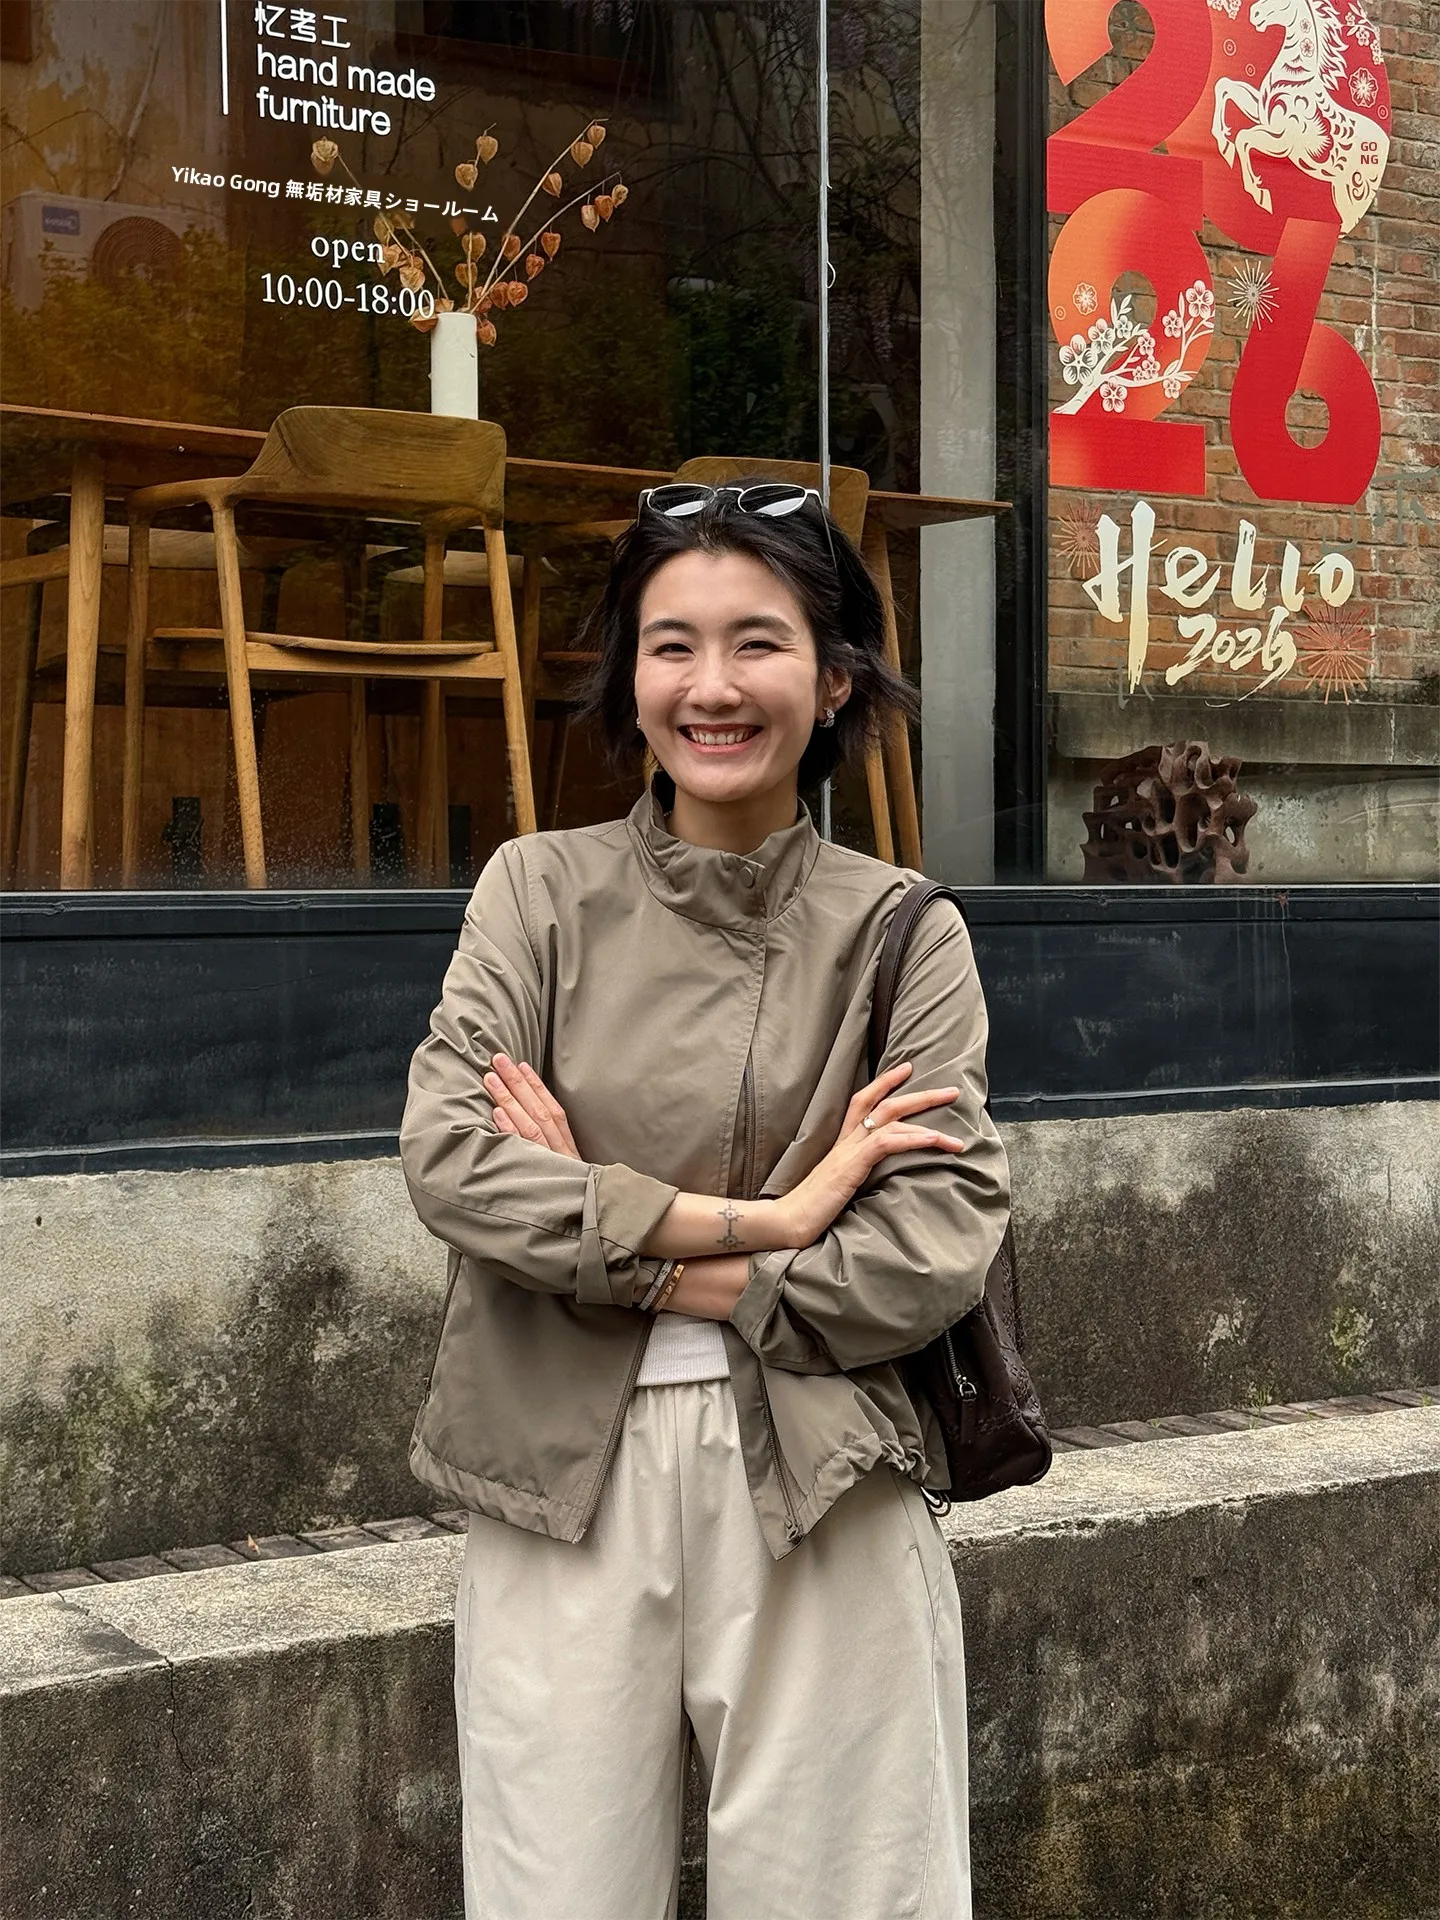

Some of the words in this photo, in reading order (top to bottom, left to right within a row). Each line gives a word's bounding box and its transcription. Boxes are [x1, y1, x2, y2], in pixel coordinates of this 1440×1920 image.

[253, 0, 351, 49] 忆考工
[256, 43, 338, 88] hand
[347, 68, 436, 102] made
[256, 86, 391, 136] furniture
[1360, 141, 1378, 152] GO
[1360, 154, 1379, 165] NG
[171, 166, 226, 188] Yikao
[230, 174, 281, 198] Gong
[285, 178, 500, 223] 無垢材家具ショールーム
[311, 236, 386, 269] open
[261, 272, 435, 319] 10:00-18:00
[1081, 500, 1355, 695] Hello
[1165, 606, 1298, 702] 2026
